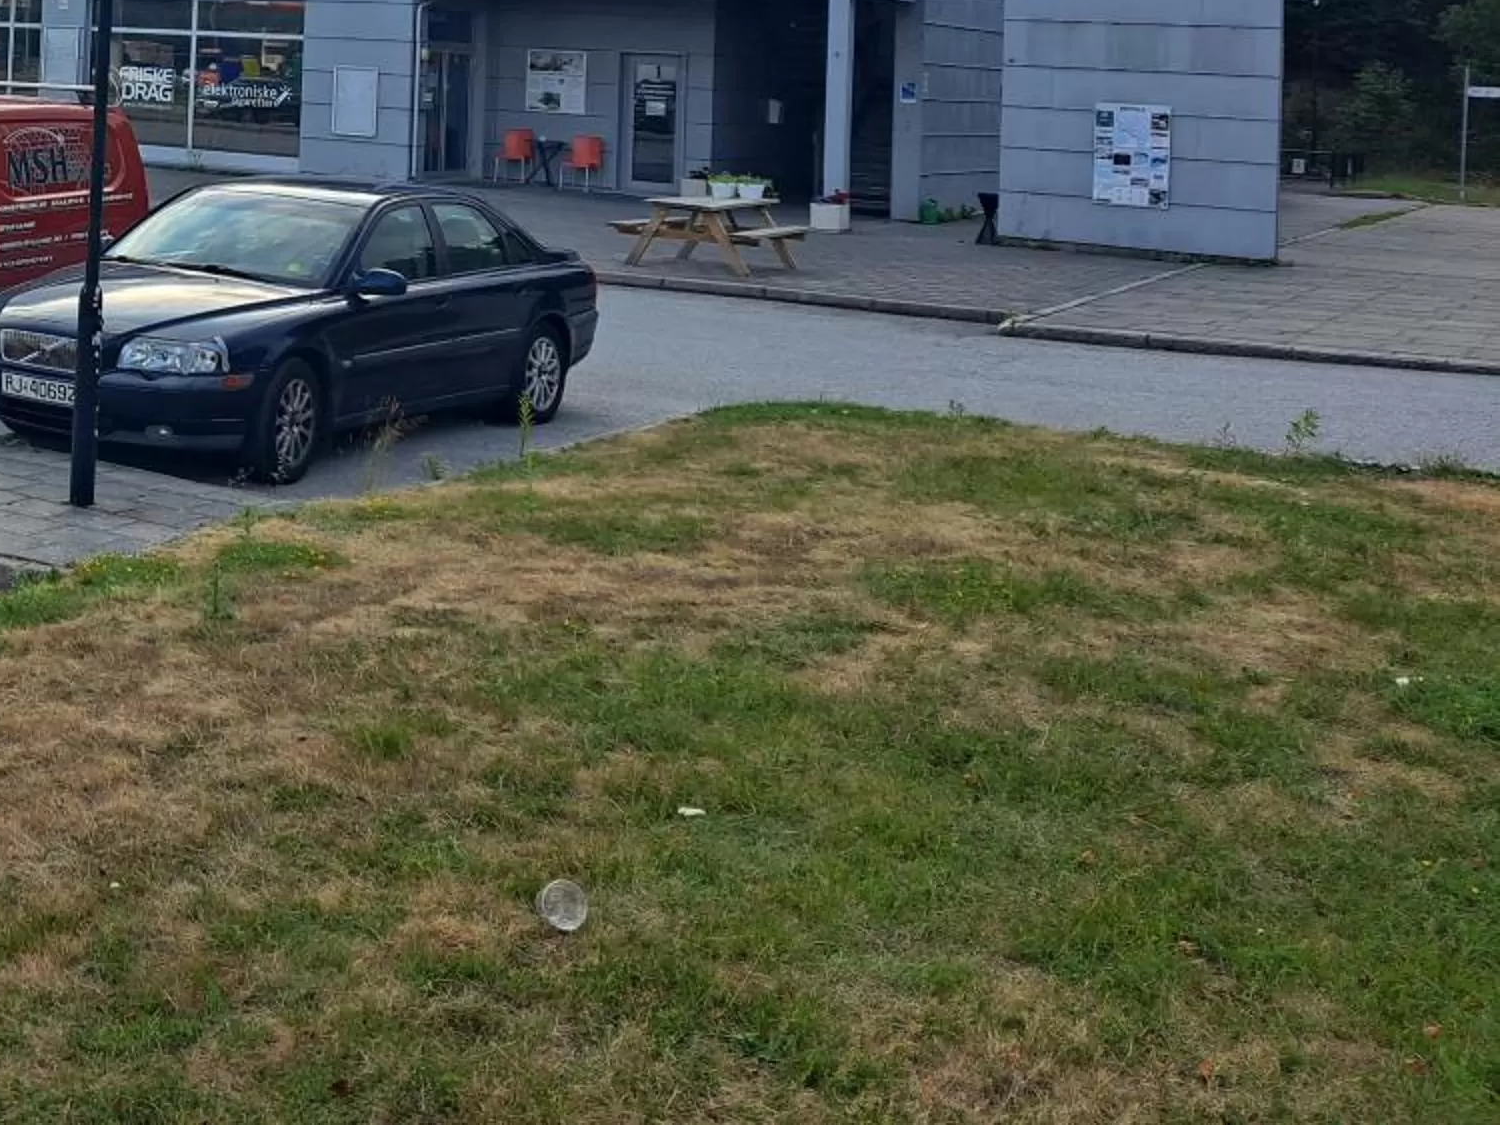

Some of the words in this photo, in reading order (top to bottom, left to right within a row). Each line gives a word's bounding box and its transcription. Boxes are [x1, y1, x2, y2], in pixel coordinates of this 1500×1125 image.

[119, 65, 175, 83] FRISKE
[121, 82, 173, 101] DRAG
[203, 83, 277, 99] elektroniske
[8, 146, 68, 188] MSH
